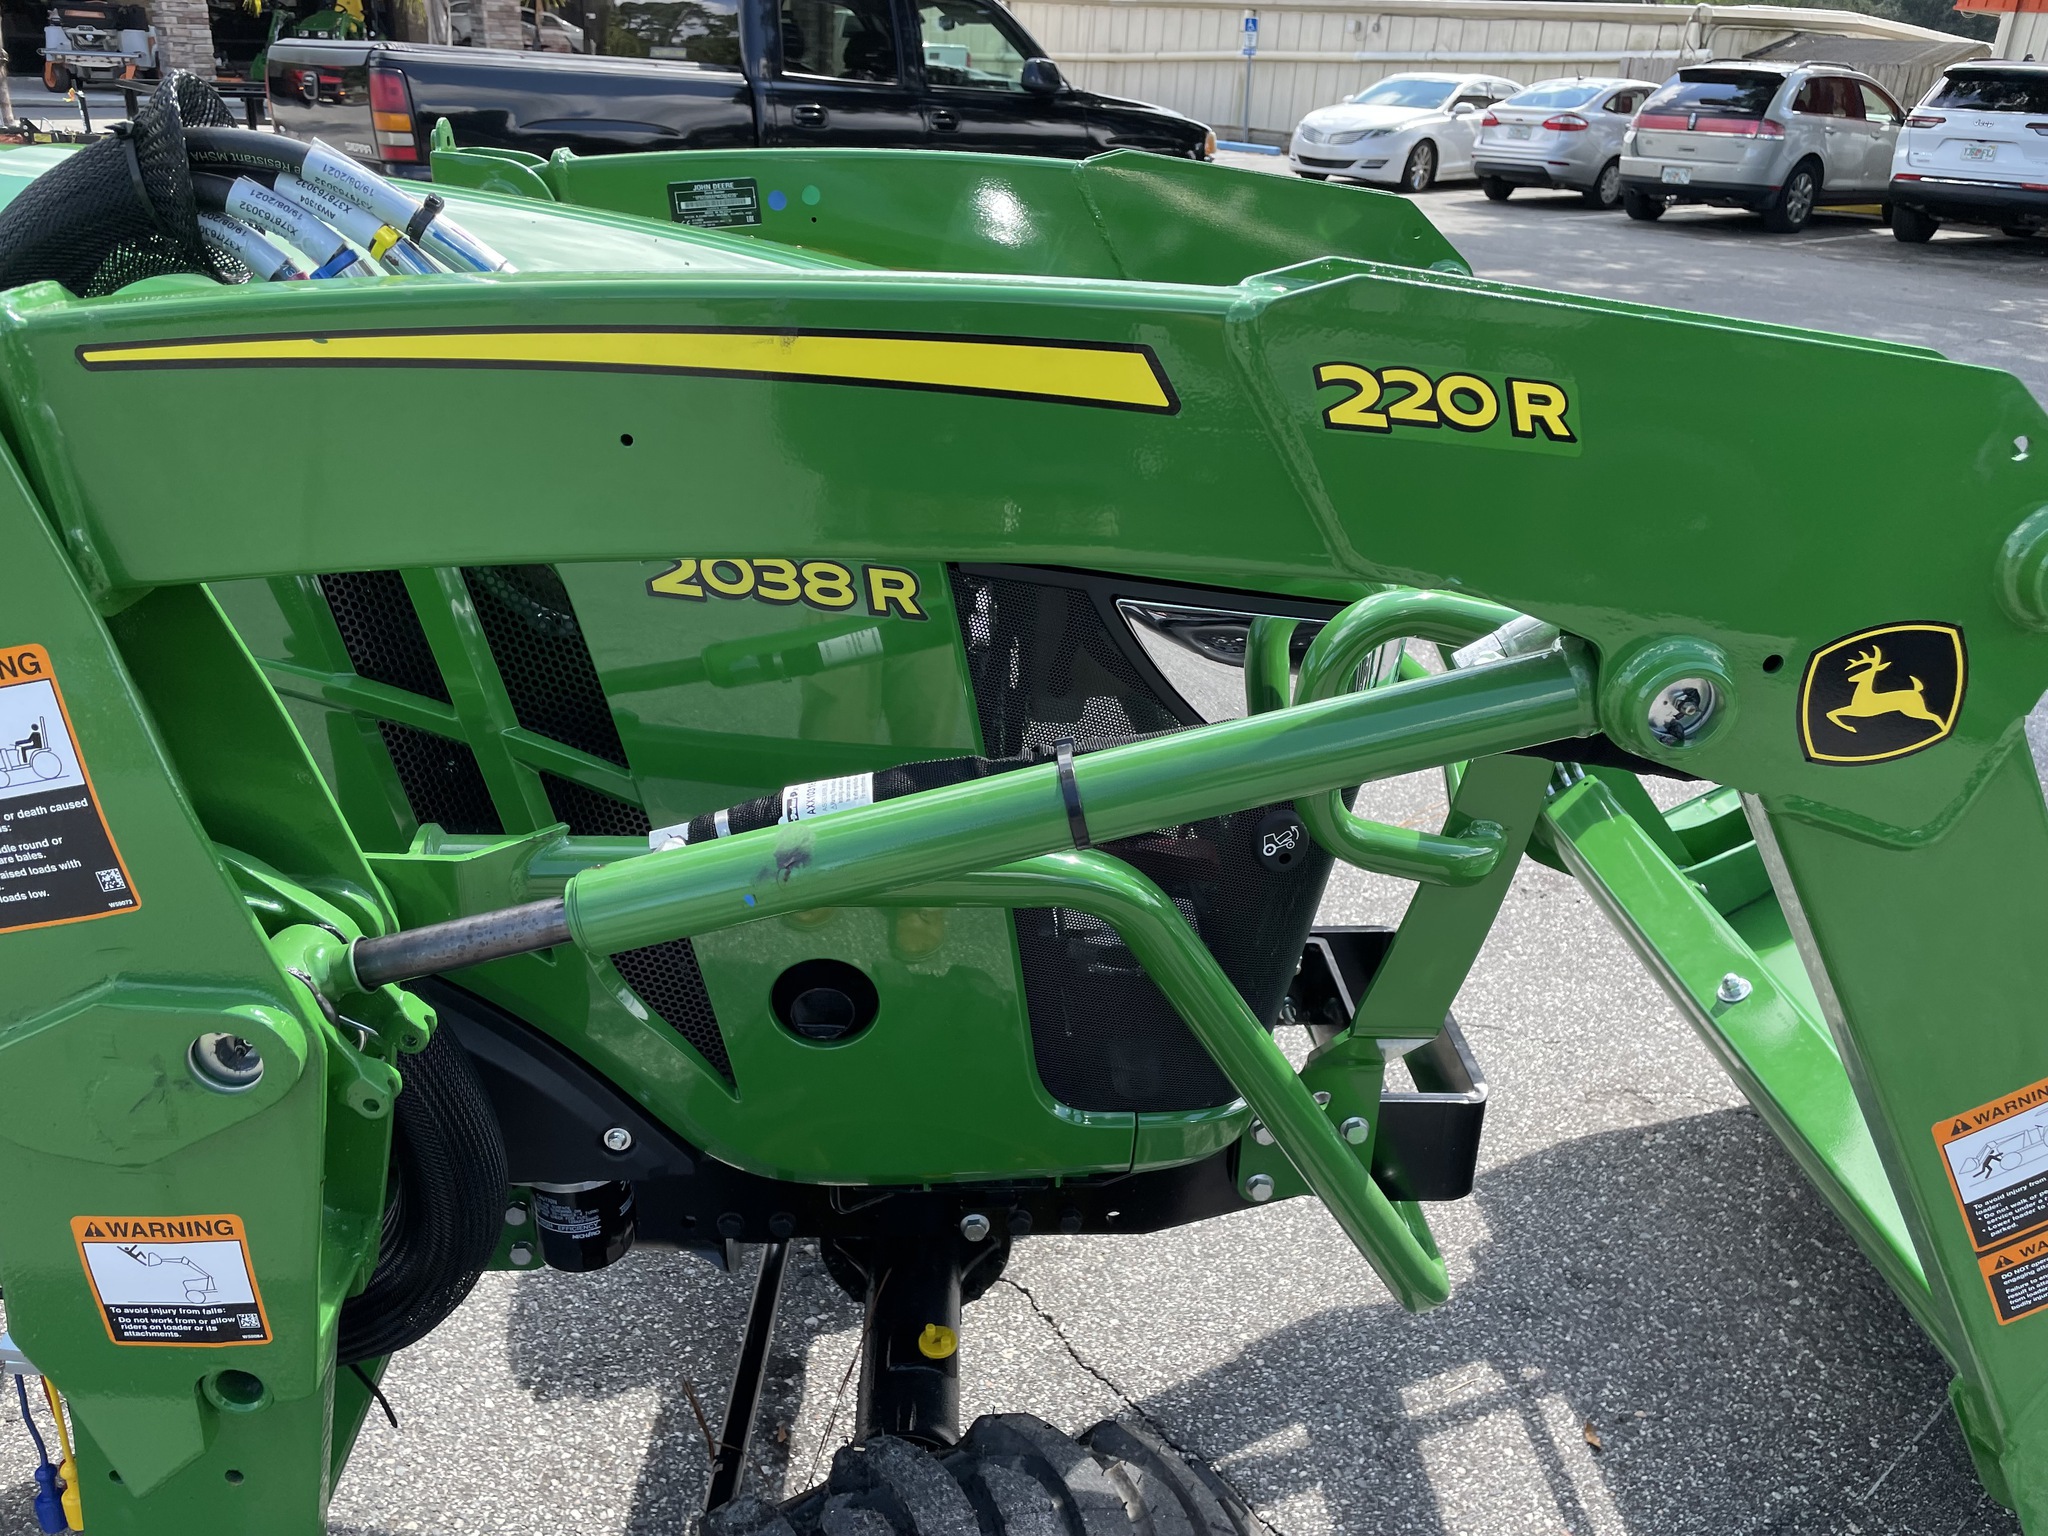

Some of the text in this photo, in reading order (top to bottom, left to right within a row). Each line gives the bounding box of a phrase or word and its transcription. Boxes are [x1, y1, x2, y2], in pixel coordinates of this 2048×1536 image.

[1973, 119, 1995, 129] Jeep
[344, 141, 373, 155] SIERRA
[189, 150, 228, 164] MSHA
[231, 152, 291, 173] Resistant
[322, 162, 376, 197] 19/08/2021
[693, 182, 734, 191] JOHN DEERE
[249, 187, 304, 221] 19/08/2021
[294, 178, 353, 214] X378763032
[1313, 361, 1579, 444] 220 R
[647, 558, 929, 621] 2038 R
[3, 797, 89, 822] or death caused
[19, 838, 50, 851] round
[51, 836, 63, 846] or
[17, 851, 47, 862] bales.
[28, 863, 58, 876] loads
[58, 859, 82, 871] with
[28, 888, 50, 900] low.
[1984, 1193, 2006, 1205] avoid
[2006, 1184, 2028, 1197] injury
[2028, 1176, 2048, 1187] from
[1983, 1211, 1995, 1219] Do
[1996, 1205, 2010, 1213] not
[2010, 1197, 2028, 1208] walk
[1986, 1211, 2014, 1225] service
[2014, 1202, 2036, 1213] under
[558, 1222, 599, 1231] EFFICIENCY
[1988, 1219, 2011, 1231] Lower
[2012, 1208, 2036, 1221] loader
[105, 1220, 234, 1238] WARNING
[1990, 1222, 2019, 1238] parked.
[2001, 1271, 2013, 1280] DO
[2013, 1264, 2031, 1275] NOT
[2003, 1269, 2036, 1285] engaging
[2005, 1281, 2030, 1294] Failure
[2007, 1288, 2028, 1300] result
[2009, 1295, 2027, 1305] from
[2010, 1298, 2033, 1311] bodily
[110, 1306, 226, 1316] To avoid injury from falls:
[118, 1316, 132, 1324] Do
[133, 1316, 149, 1324] not
[150, 1316, 174, 1324] work
[175, 1317, 197, 1325] from
[210, 1316, 236, 1325] allow
[120, 1323, 148, 1331] riders
